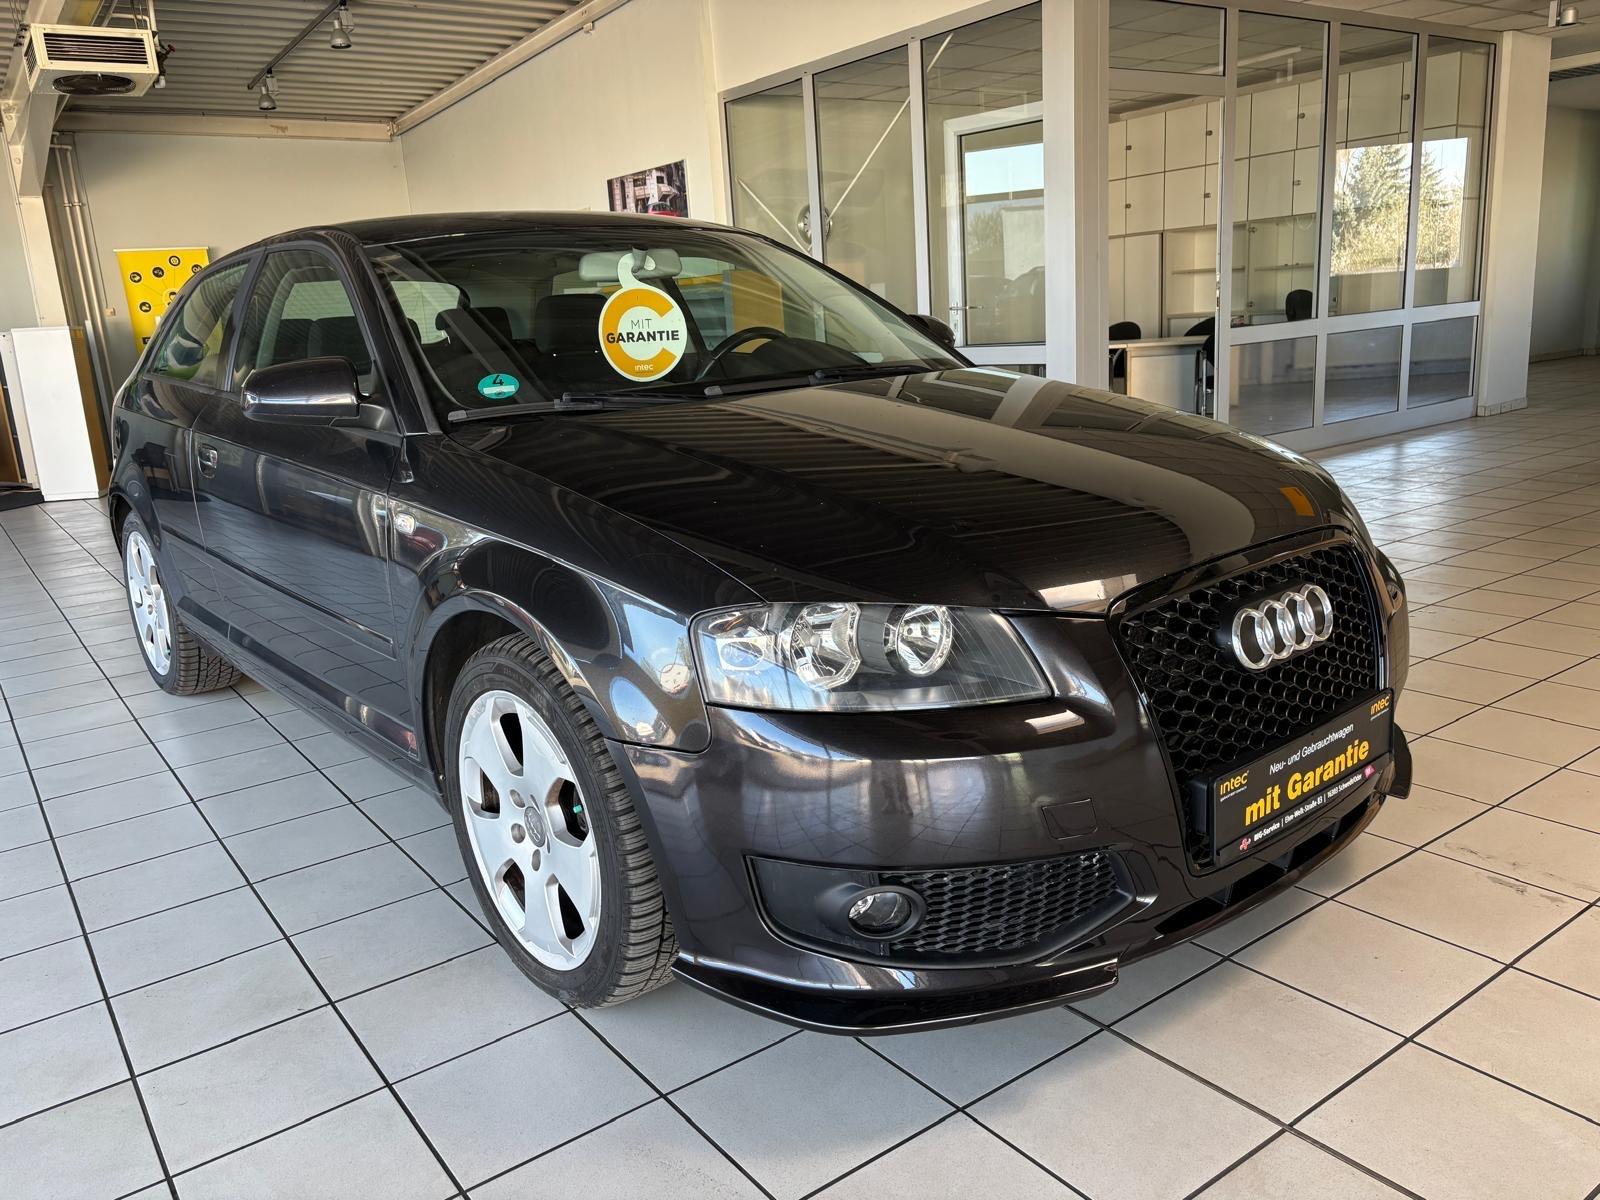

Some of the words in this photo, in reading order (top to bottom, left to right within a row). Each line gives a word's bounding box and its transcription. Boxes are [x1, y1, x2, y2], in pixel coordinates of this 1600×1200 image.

[631, 318, 652, 329] MIT
[606, 330, 680, 344] GARANTIE
[492, 375, 504, 386] 4
[1370, 695, 1390, 715] intec
[1269, 761, 1286, 775] Neu-
[1288, 750, 1301, 765] und
[1301, 723, 1354, 756] Gebrauchtwagen
[1220, 774, 1248, 795] intec
[1245, 784, 1281, 827] mit
[1287, 739, 1370, 800] Garantie
